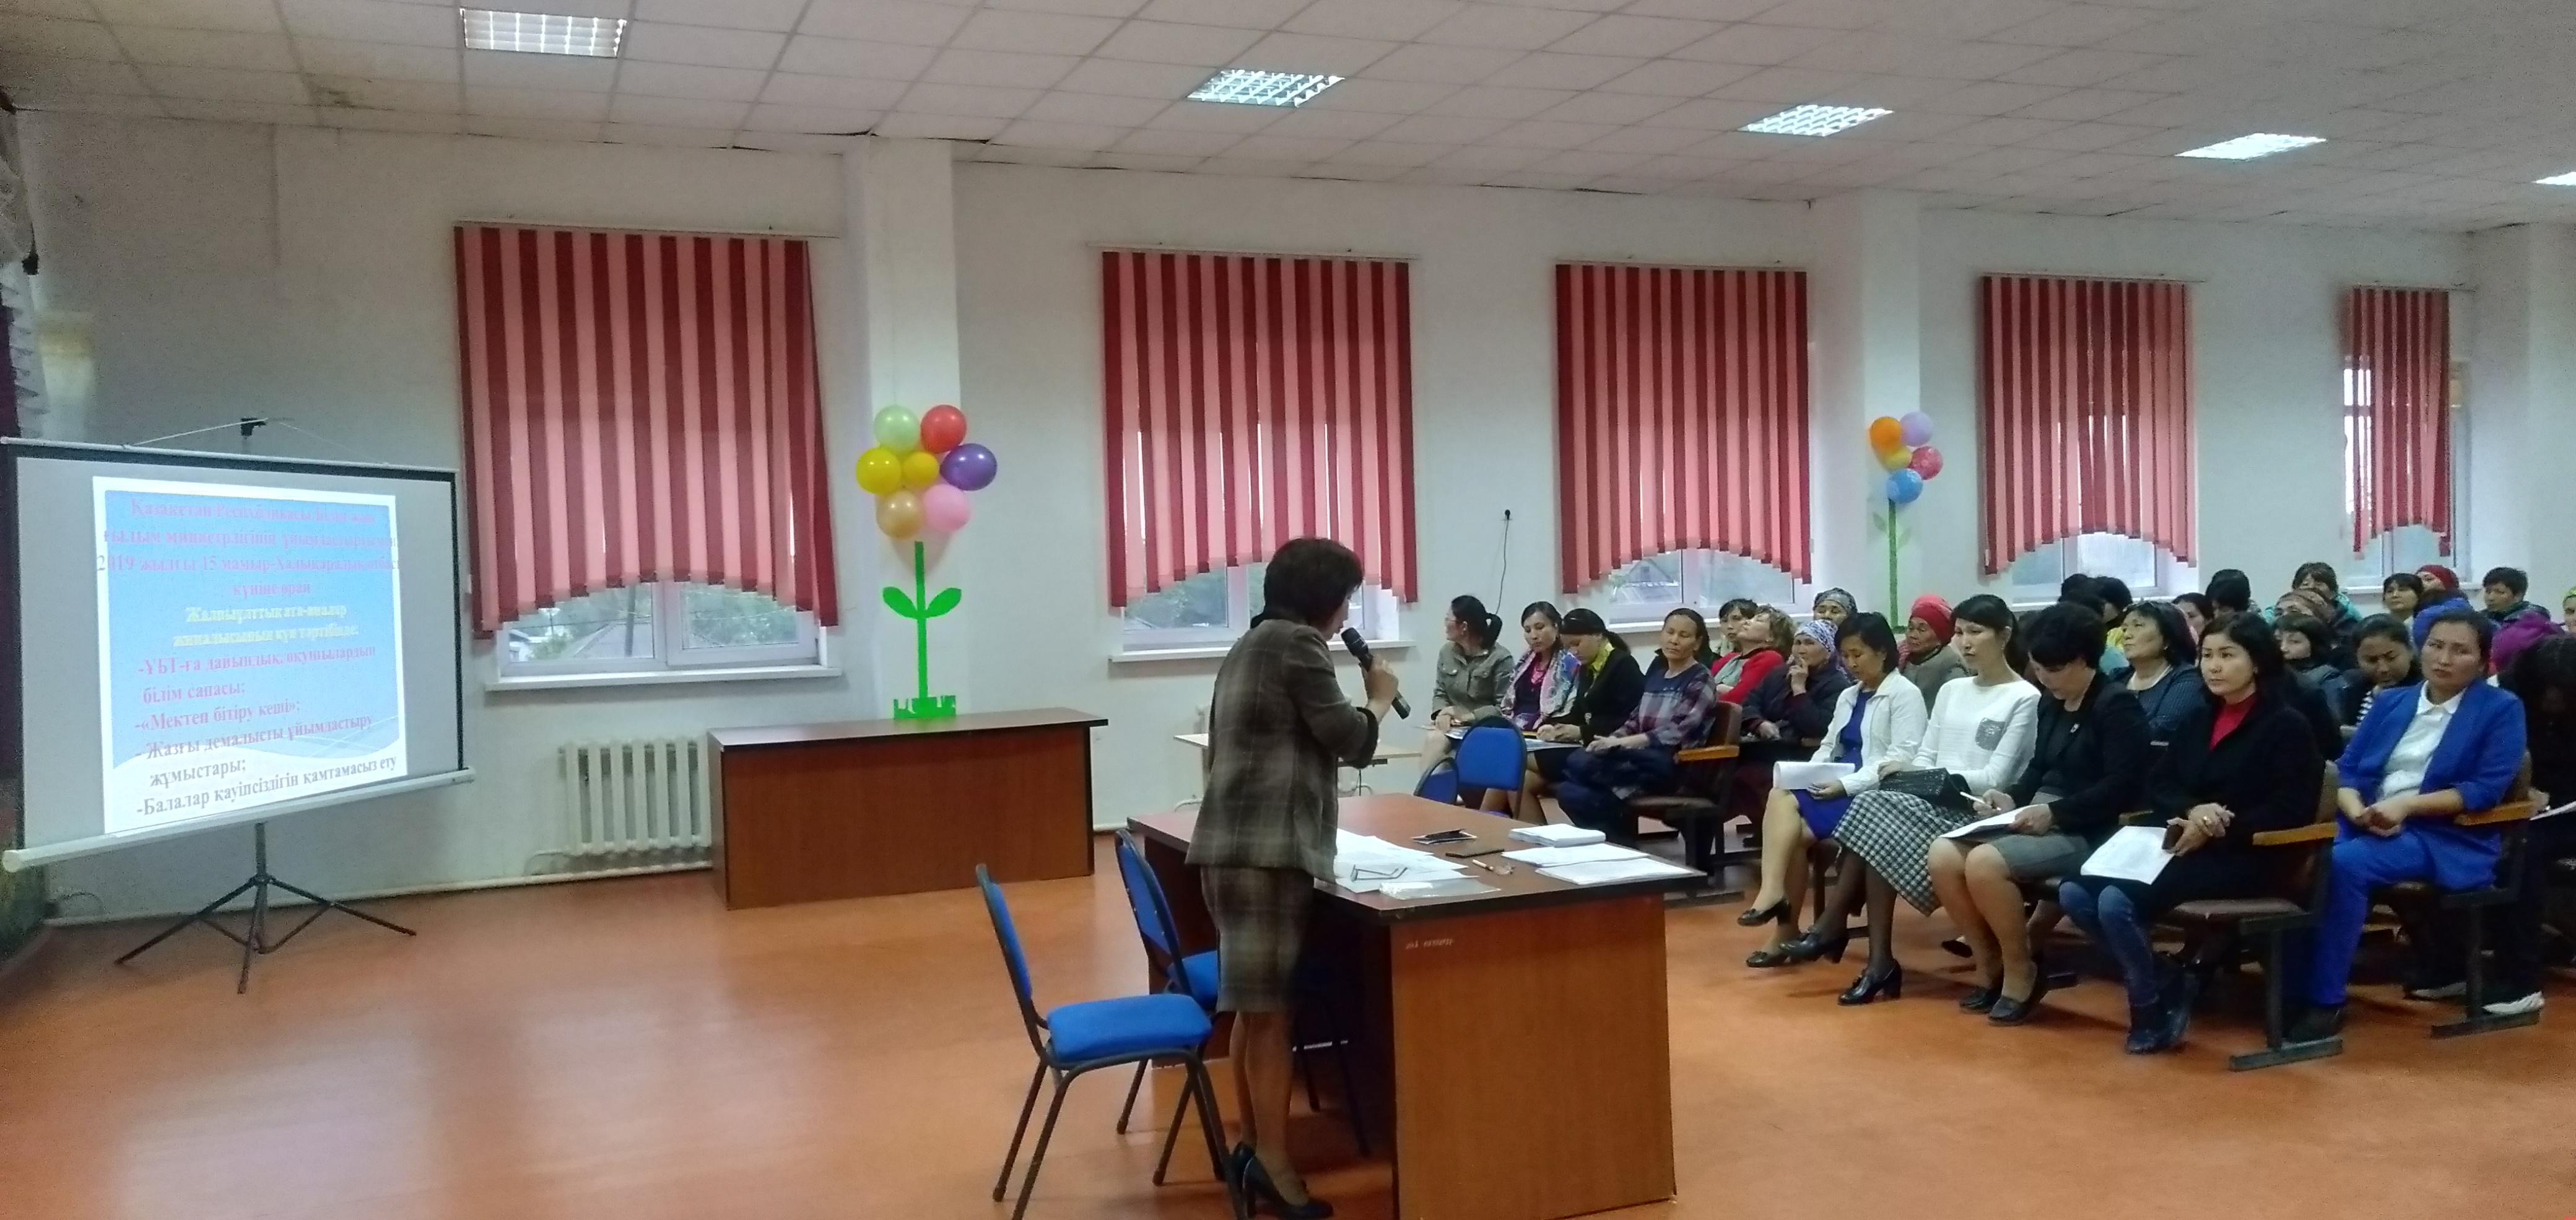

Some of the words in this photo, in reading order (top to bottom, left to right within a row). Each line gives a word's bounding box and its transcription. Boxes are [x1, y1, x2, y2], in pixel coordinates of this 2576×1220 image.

[97, 555, 135, 570] 2019
[202, 555, 217, 570] 15
[142, 687, 182, 704] білім
[146, 740, 200, 759] Жазғы
[204, 728, 284, 752] демалысты
[137, 791, 210, 816] -Балалар
[380, 756, 397, 771] ету
[149, 759, 246, 788] жұмыстары;
